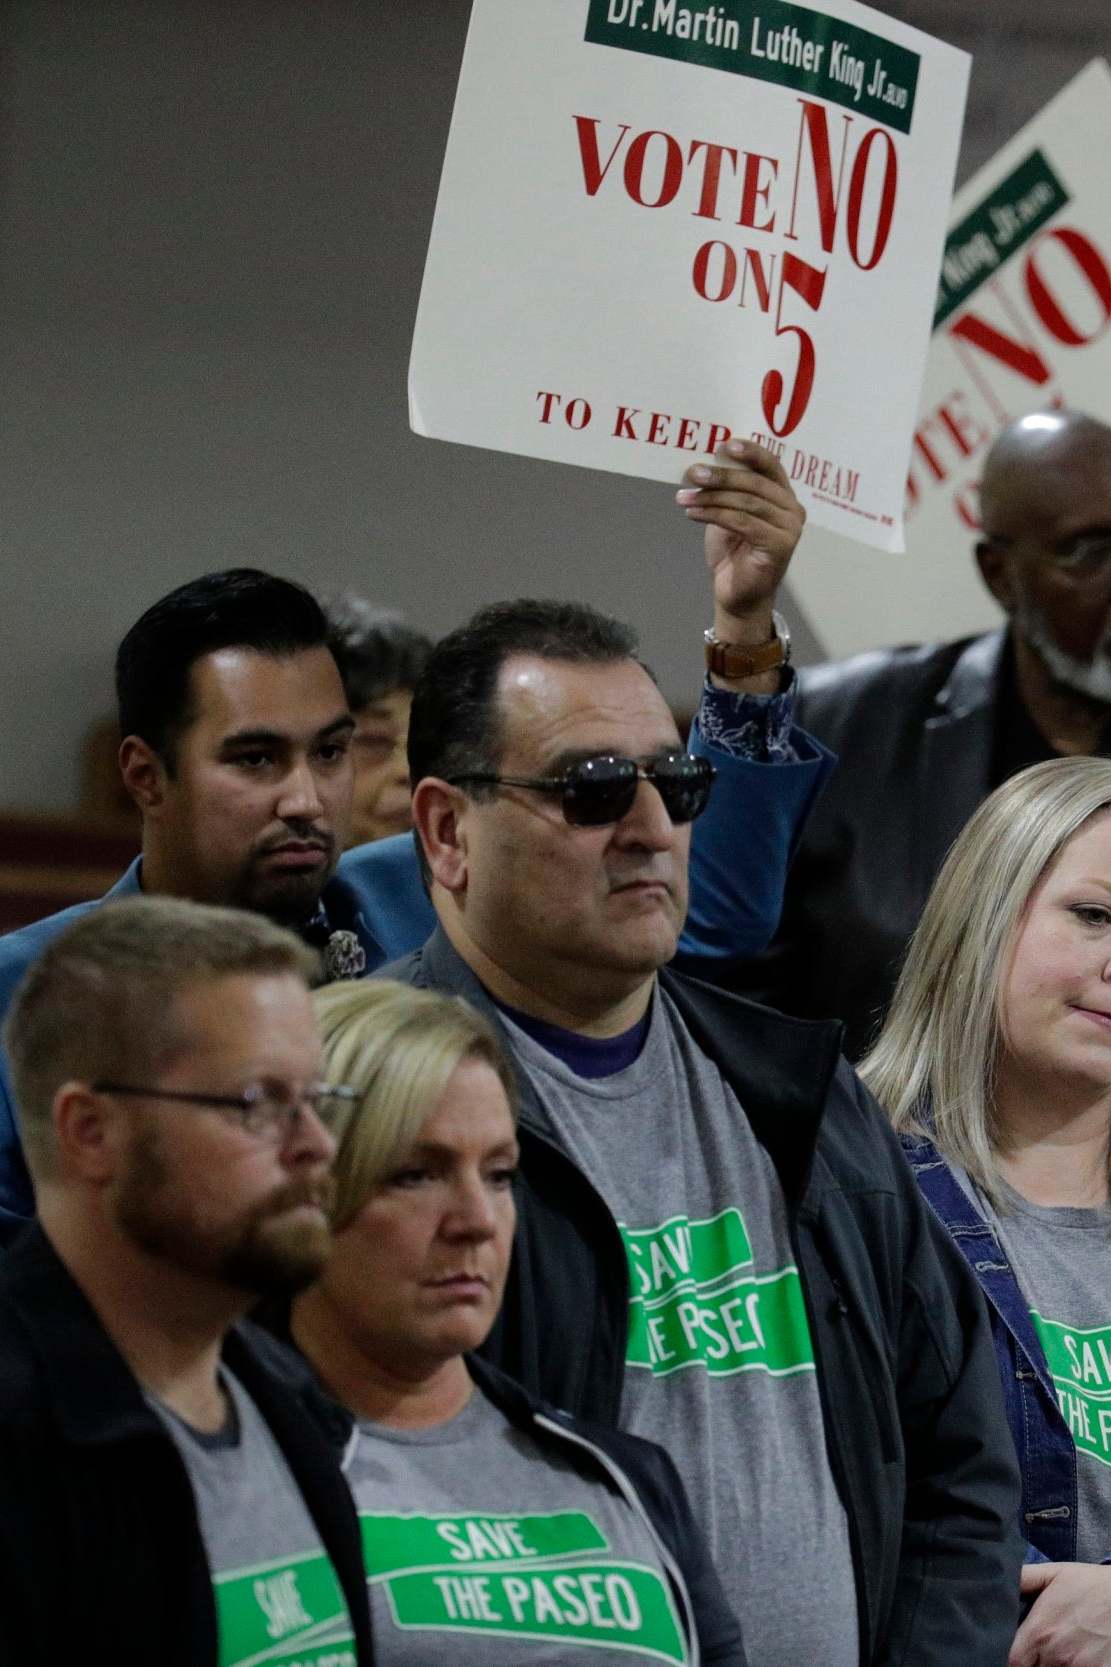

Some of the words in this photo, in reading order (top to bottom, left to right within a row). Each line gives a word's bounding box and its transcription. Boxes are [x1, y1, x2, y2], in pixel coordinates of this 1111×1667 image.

[751, 17, 824, 73] Luther
[828, 40, 864, 102] King
[572, 115, 779, 233] VOTE
[784, 98, 897, 271] NO
[692, 240, 777, 313] ON
[760, 250, 829, 438] 5
[536, 391, 592, 430] TO
[611, 406, 732, 455] KEEP
[790, 449, 860, 501] DREAM
[629, 1225, 693, 1294] SAV
[1055, 1389, 1097, 1444] THE
[436, 1519, 538, 1561] SAVE
[433, 1576, 503, 1621] THE
[501, 1572, 643, 1631] PASEO
